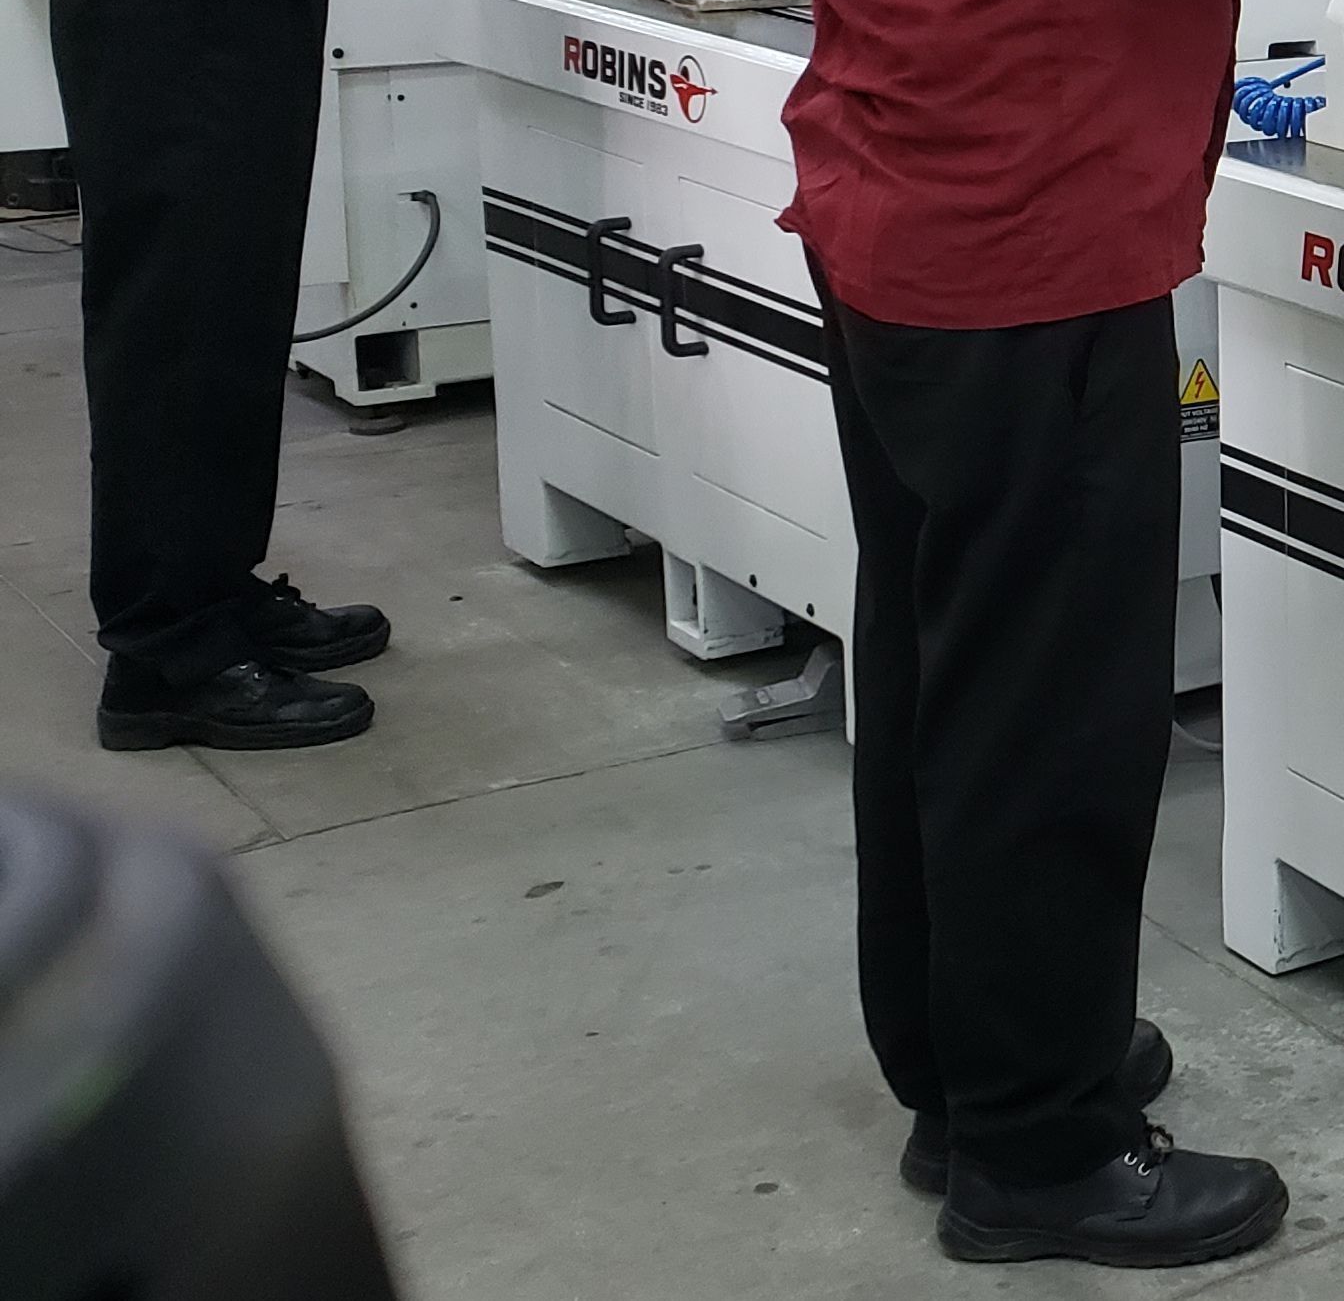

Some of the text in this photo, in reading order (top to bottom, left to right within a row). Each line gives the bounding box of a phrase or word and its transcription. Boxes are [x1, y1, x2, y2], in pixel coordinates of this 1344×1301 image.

[564, 35, 667, 100] ROBINS
[618, 91, 669, 117] SINCE 1983
